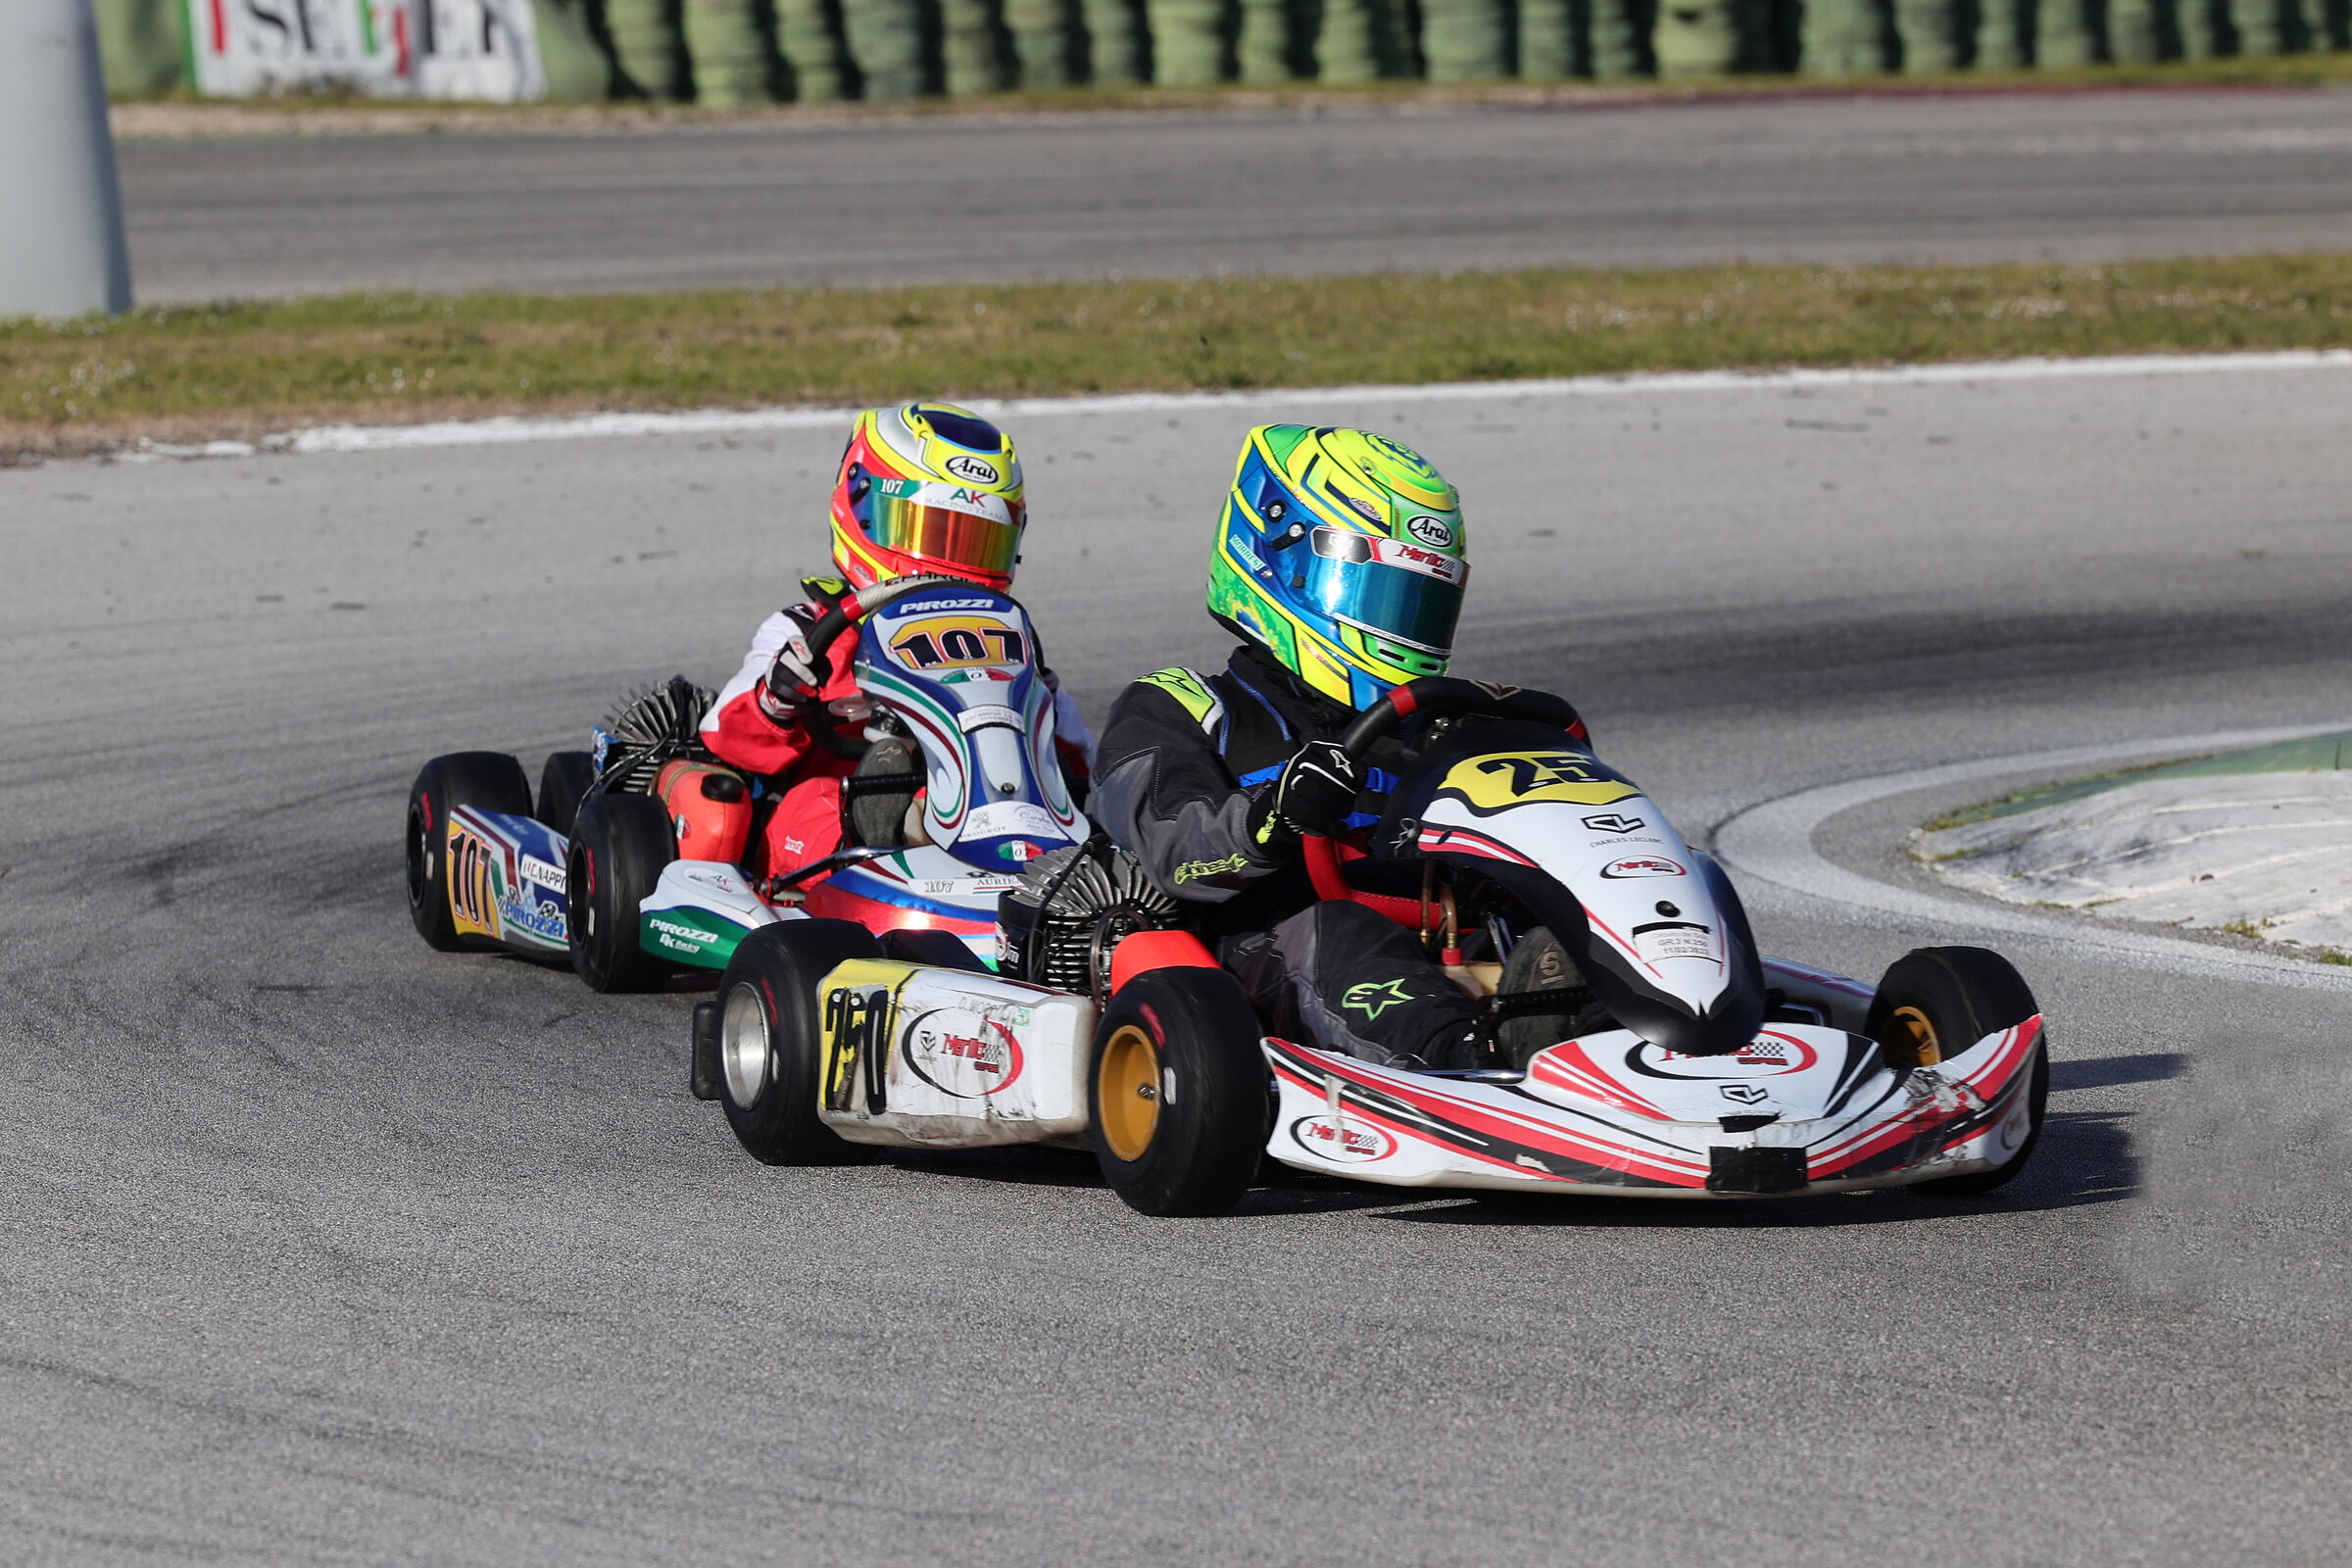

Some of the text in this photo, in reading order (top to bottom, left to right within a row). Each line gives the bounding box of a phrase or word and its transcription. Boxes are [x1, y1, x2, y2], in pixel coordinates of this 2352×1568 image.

[949, 459, 993, 479] Arai
[880, 478, 904, 494] 107
[950, 487, 987, 509] AK
[1411, 518, 1448, 542] Arai
[900, 599, 995, 614] PIROZZI
[888, 626, 1030, 670] 107
[448, 826, 495, 938] 107
[924, 881, 955, 893] 107
[505, 901, 565, 938] PIROZZI
[649, 918, 719, 944] PIROZZI
